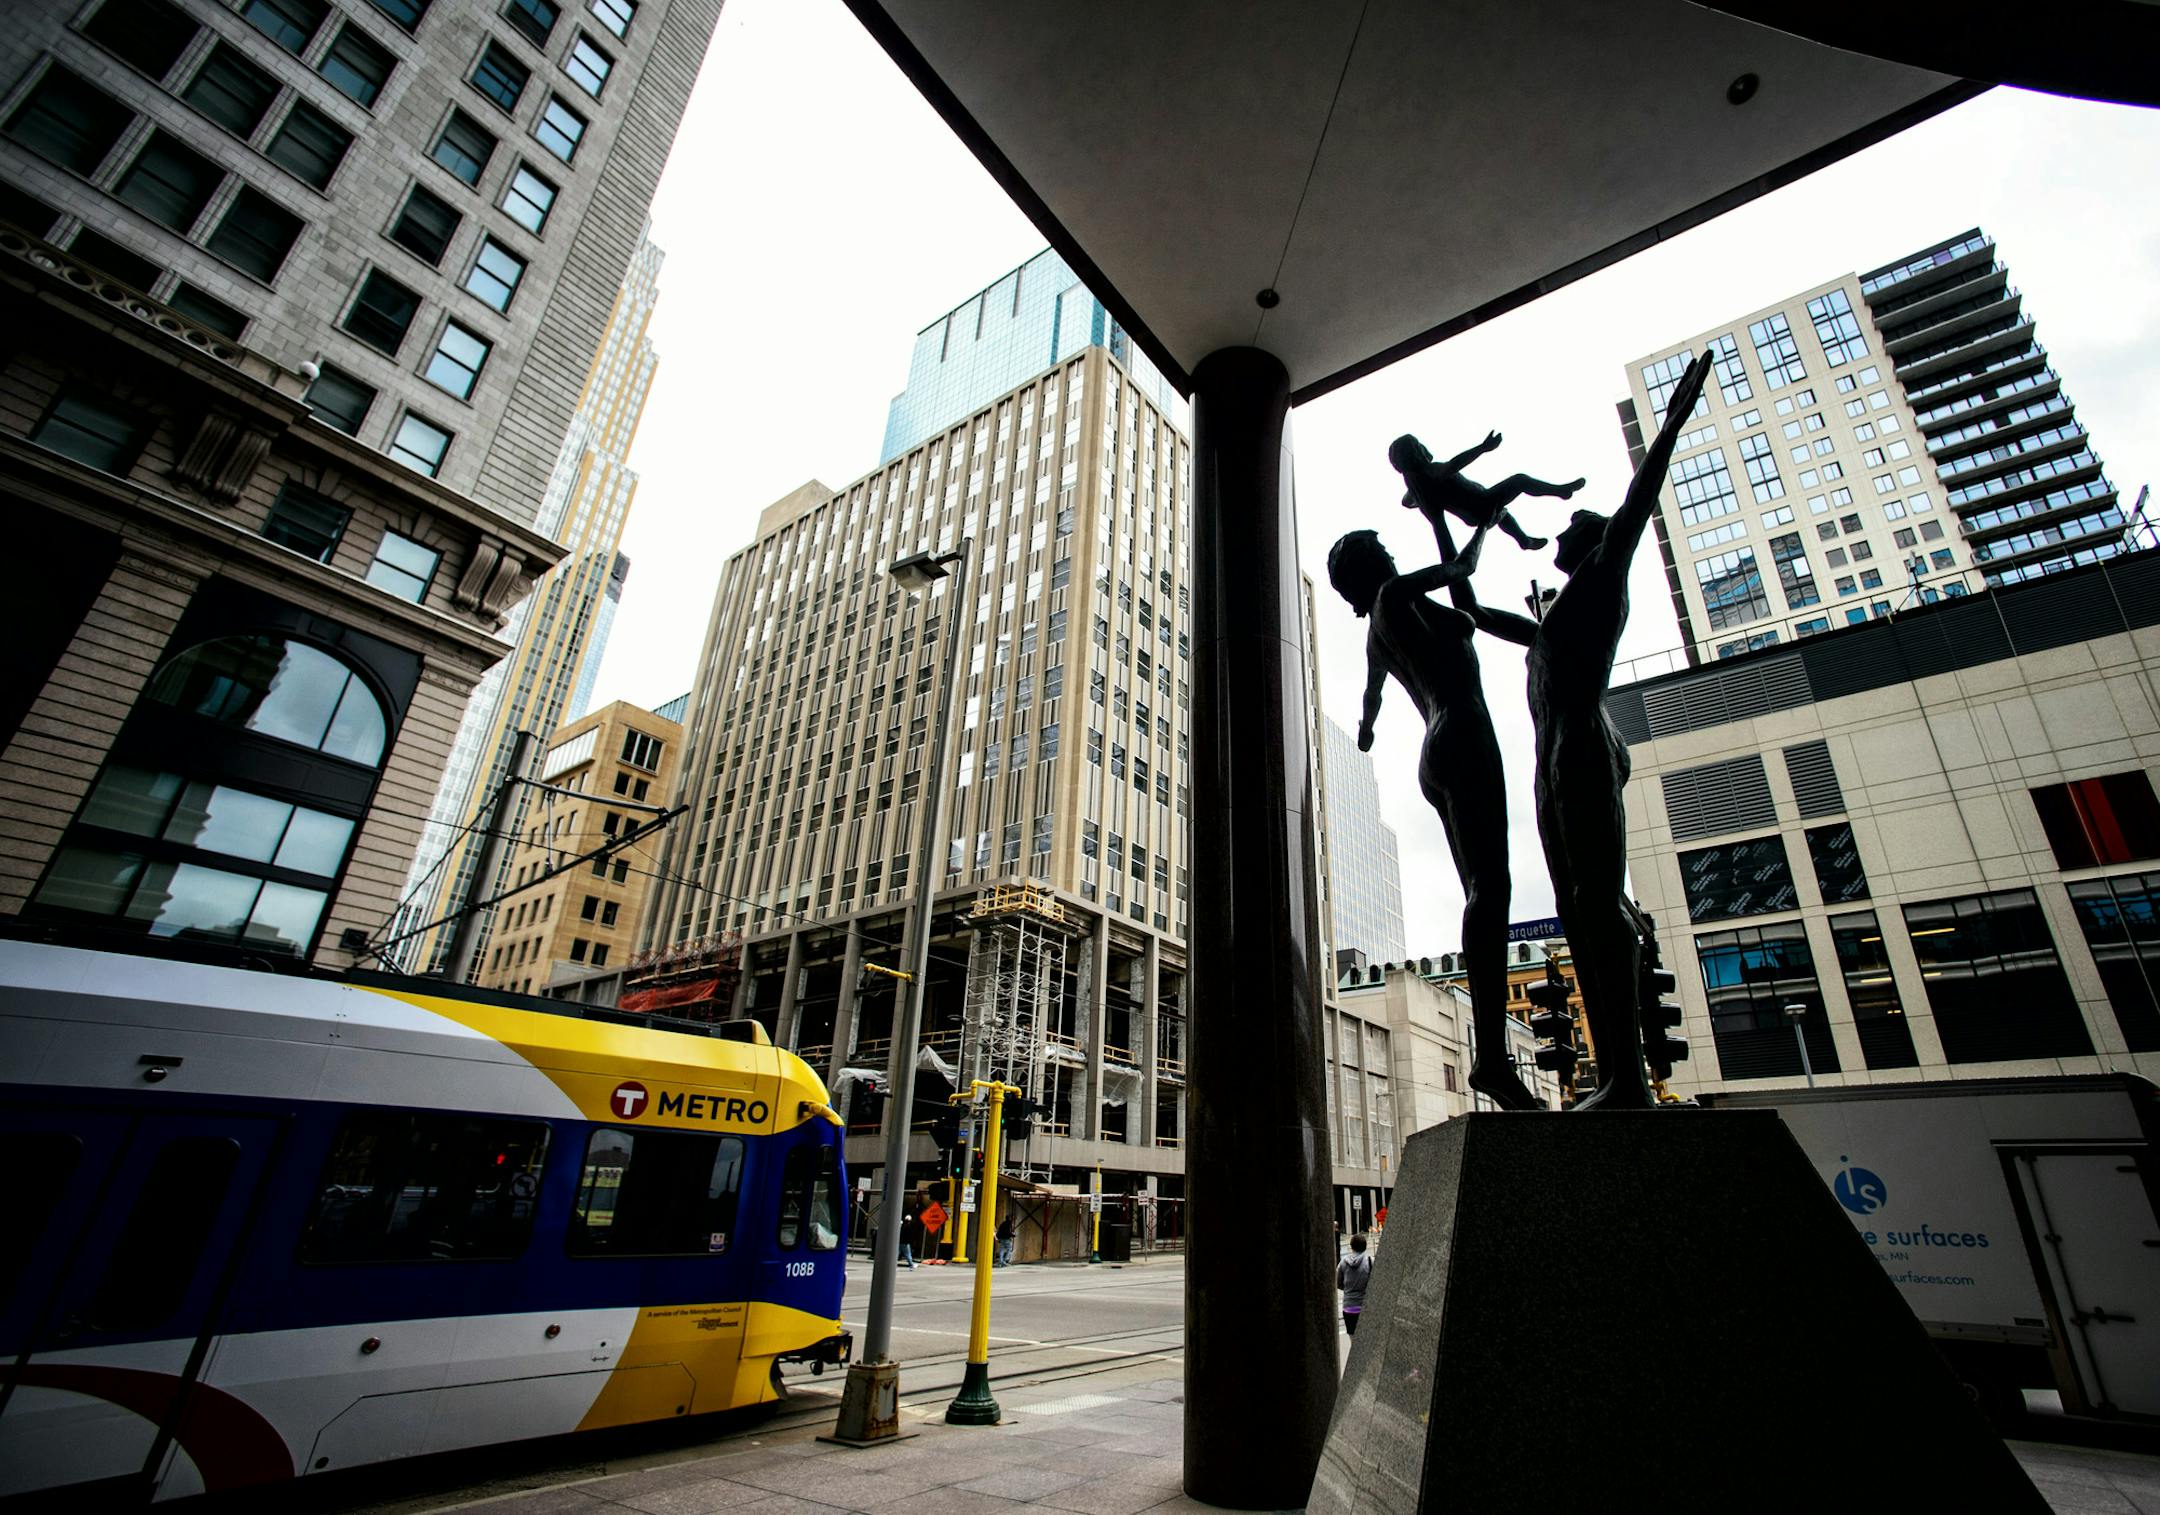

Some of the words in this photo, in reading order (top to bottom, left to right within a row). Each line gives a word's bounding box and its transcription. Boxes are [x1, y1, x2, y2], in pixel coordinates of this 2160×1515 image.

[1508, 922, 1556, 940] arquette
[657, 1091, 769, 1124] METRO
[1887, 1224, 1989, 1248] surfaces
[785, 1262, 815, 1277] 108B
